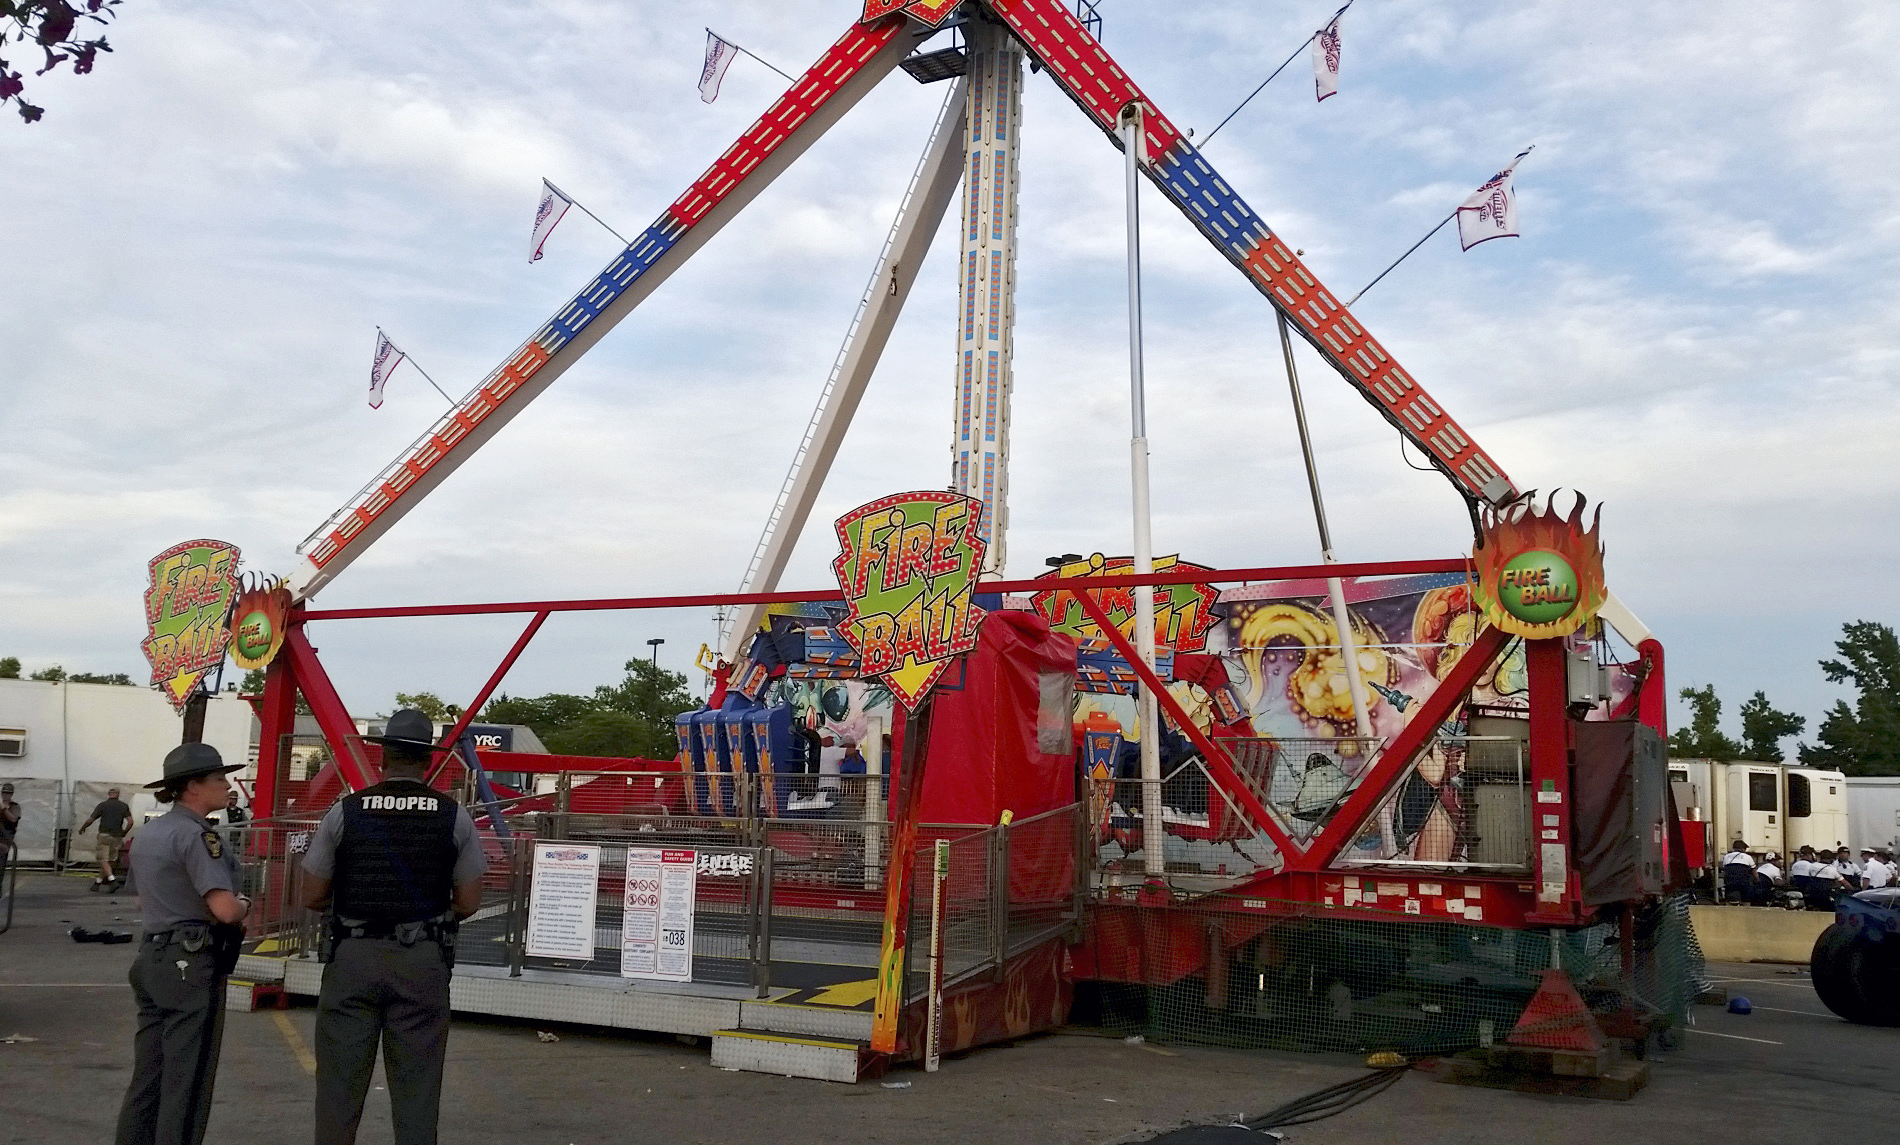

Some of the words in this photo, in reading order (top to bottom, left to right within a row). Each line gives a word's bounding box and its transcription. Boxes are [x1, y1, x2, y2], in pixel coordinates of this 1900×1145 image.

[1501, 567, 1551, 588] FIRE
[1519, 583, 1573, 606] BALL
[239, 622, 261, 638] FIRE
[854, 581, 978, 679] BALL
[150, 610, 229, 685] BALL
[246, 634, 269, 648] BALL
[474, 734, 502, 747] YRC
[361, 795, 439, 811] TROOPER
[700, 854, 750, 870] ENTER
[669, 932, 685, 946] 038
